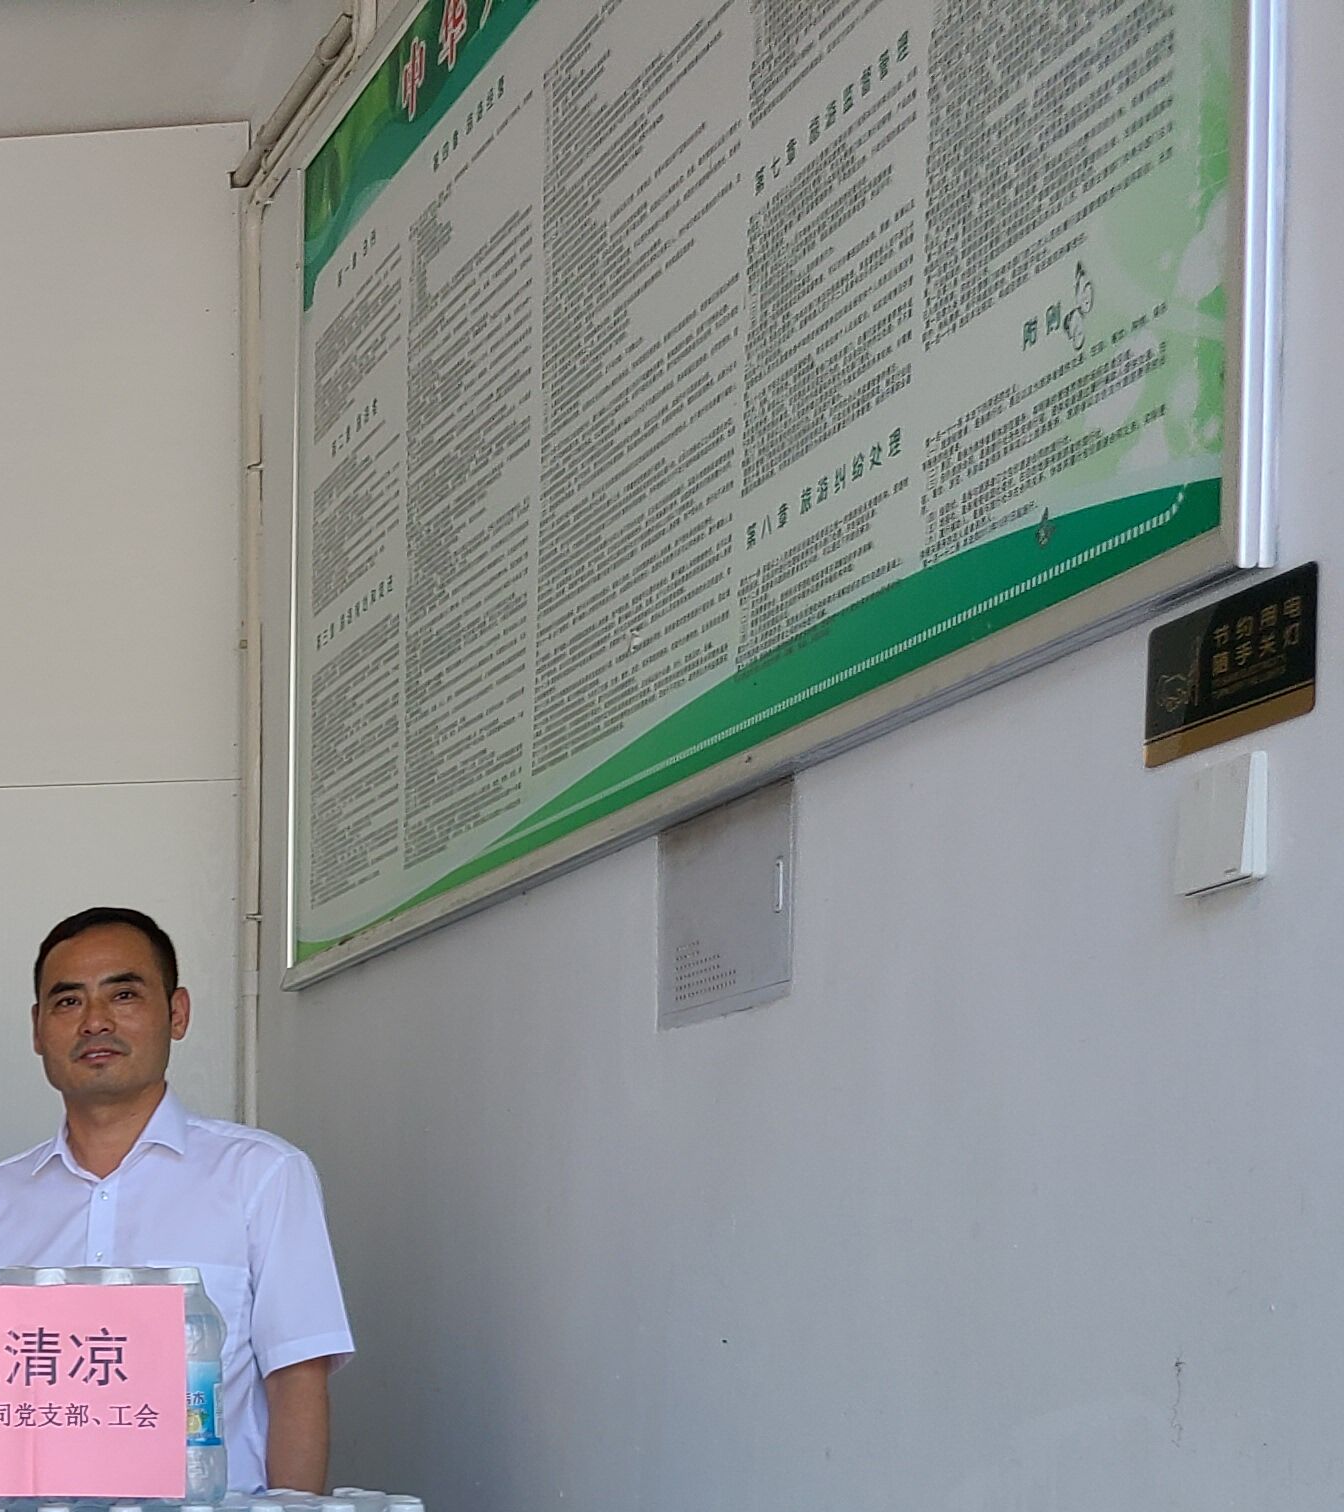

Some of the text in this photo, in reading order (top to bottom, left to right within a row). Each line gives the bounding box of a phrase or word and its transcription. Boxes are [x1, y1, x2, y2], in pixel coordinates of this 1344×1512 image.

[799, 427, 902, 515] 旅游纠纷处理
